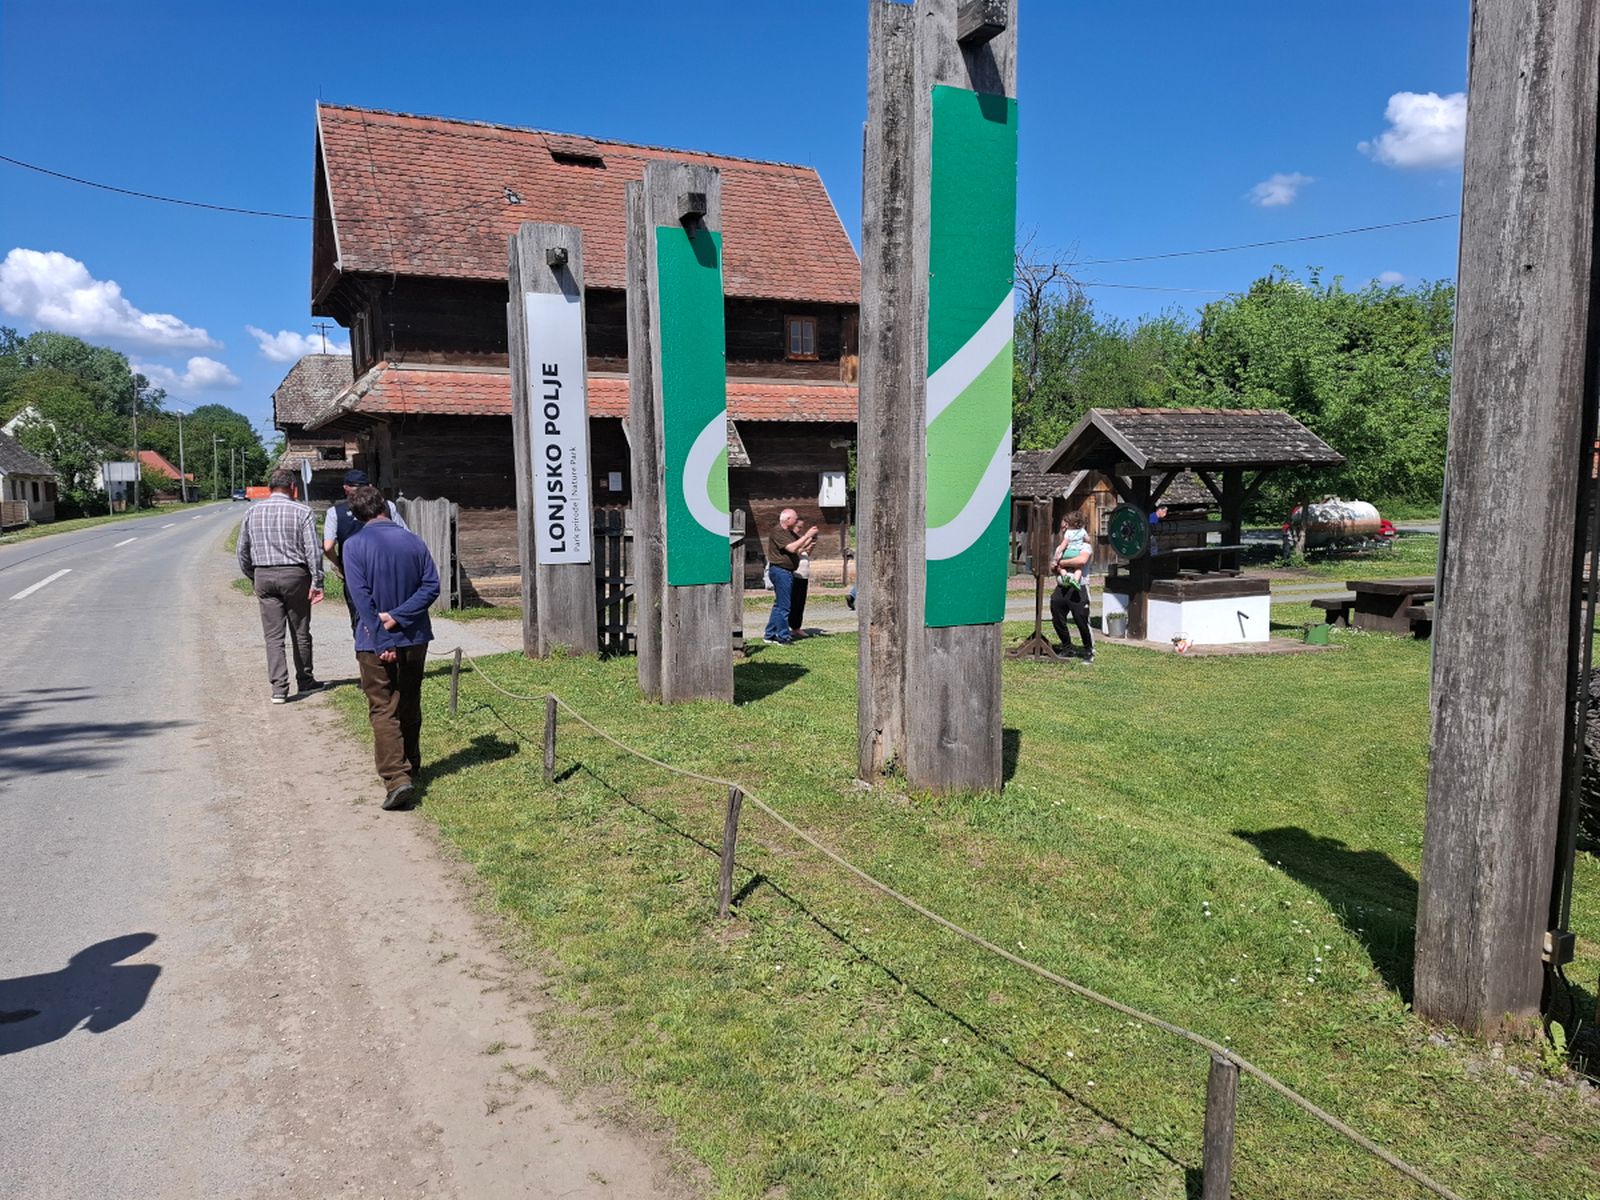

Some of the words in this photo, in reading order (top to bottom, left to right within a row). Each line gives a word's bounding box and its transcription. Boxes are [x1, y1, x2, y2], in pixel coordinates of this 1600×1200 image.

[542, 363, 562, 435] POLJE
[569, 446, 577, 465] Park
[570, 467, 578, 496] Nature
[545, 444, 567, 553] LONJSKO
[571, 502, 581, 532] prirode
[572, 533, 581, 552] Park
